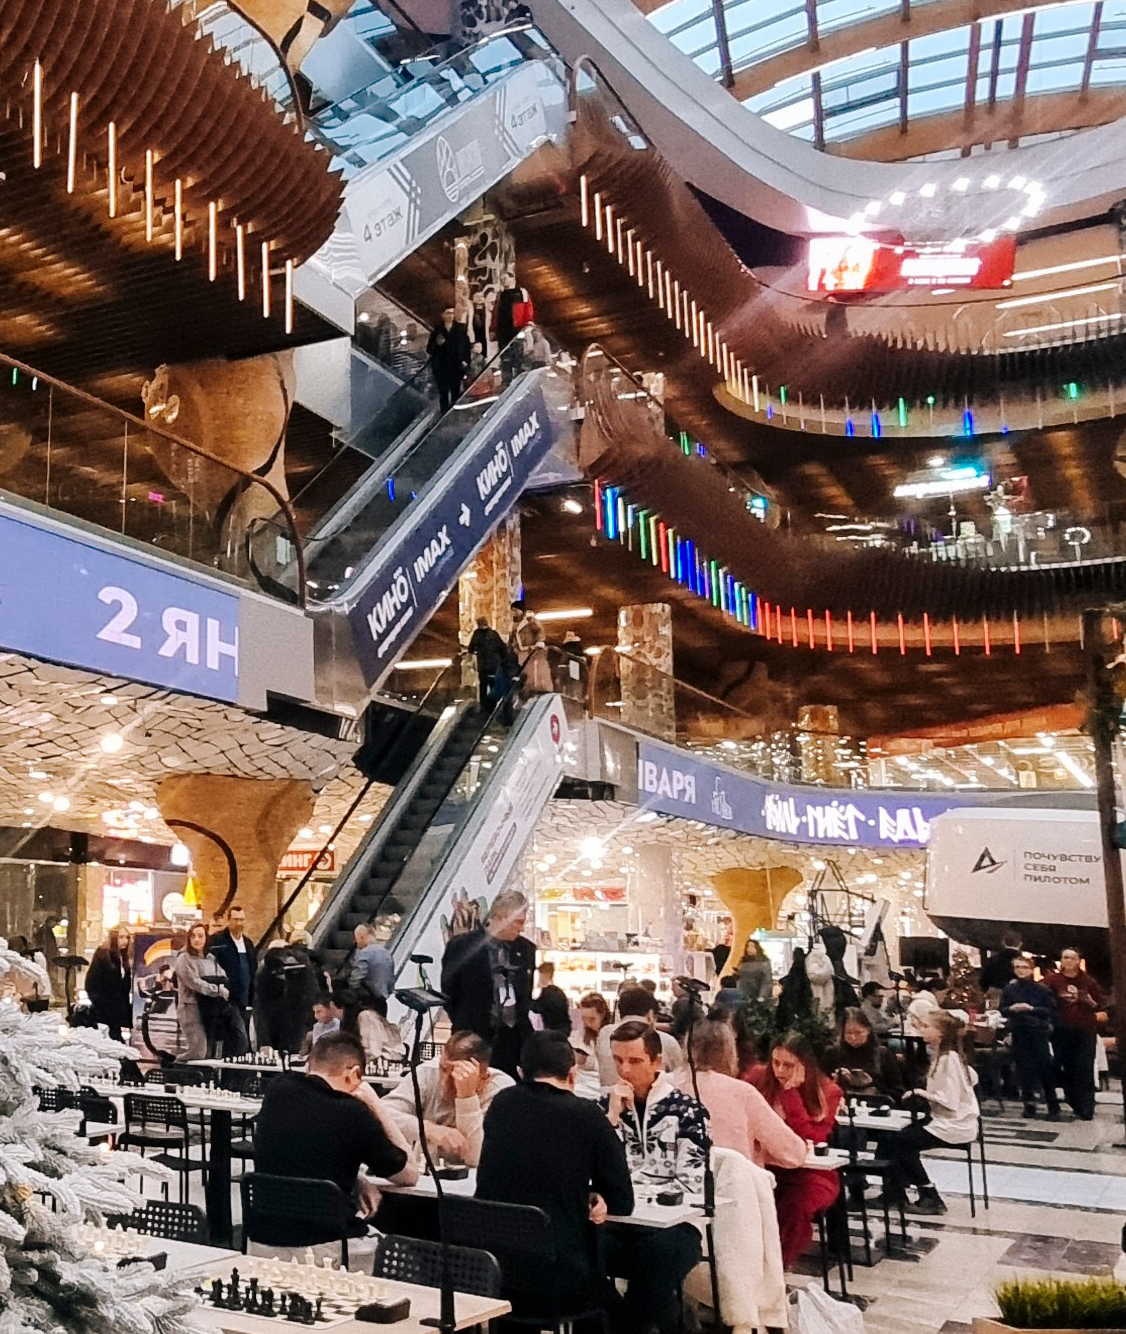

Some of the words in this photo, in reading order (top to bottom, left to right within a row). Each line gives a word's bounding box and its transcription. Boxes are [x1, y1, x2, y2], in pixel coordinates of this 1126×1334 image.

[363, 223, 372, 243] 4
[511, 411, 540, 457] IMAX
[413, 524, 451, 583] IMAX
[95, 586, 141, 650] 2
[157, 606, 239, 677] ЯН
[1024, 851, 1101, 863] ПОЧУВСТВУ
[1025, 862, 1057, 872] СЕБЯ
[1024, 873, 1090, 885] ПИЛОТОМ
